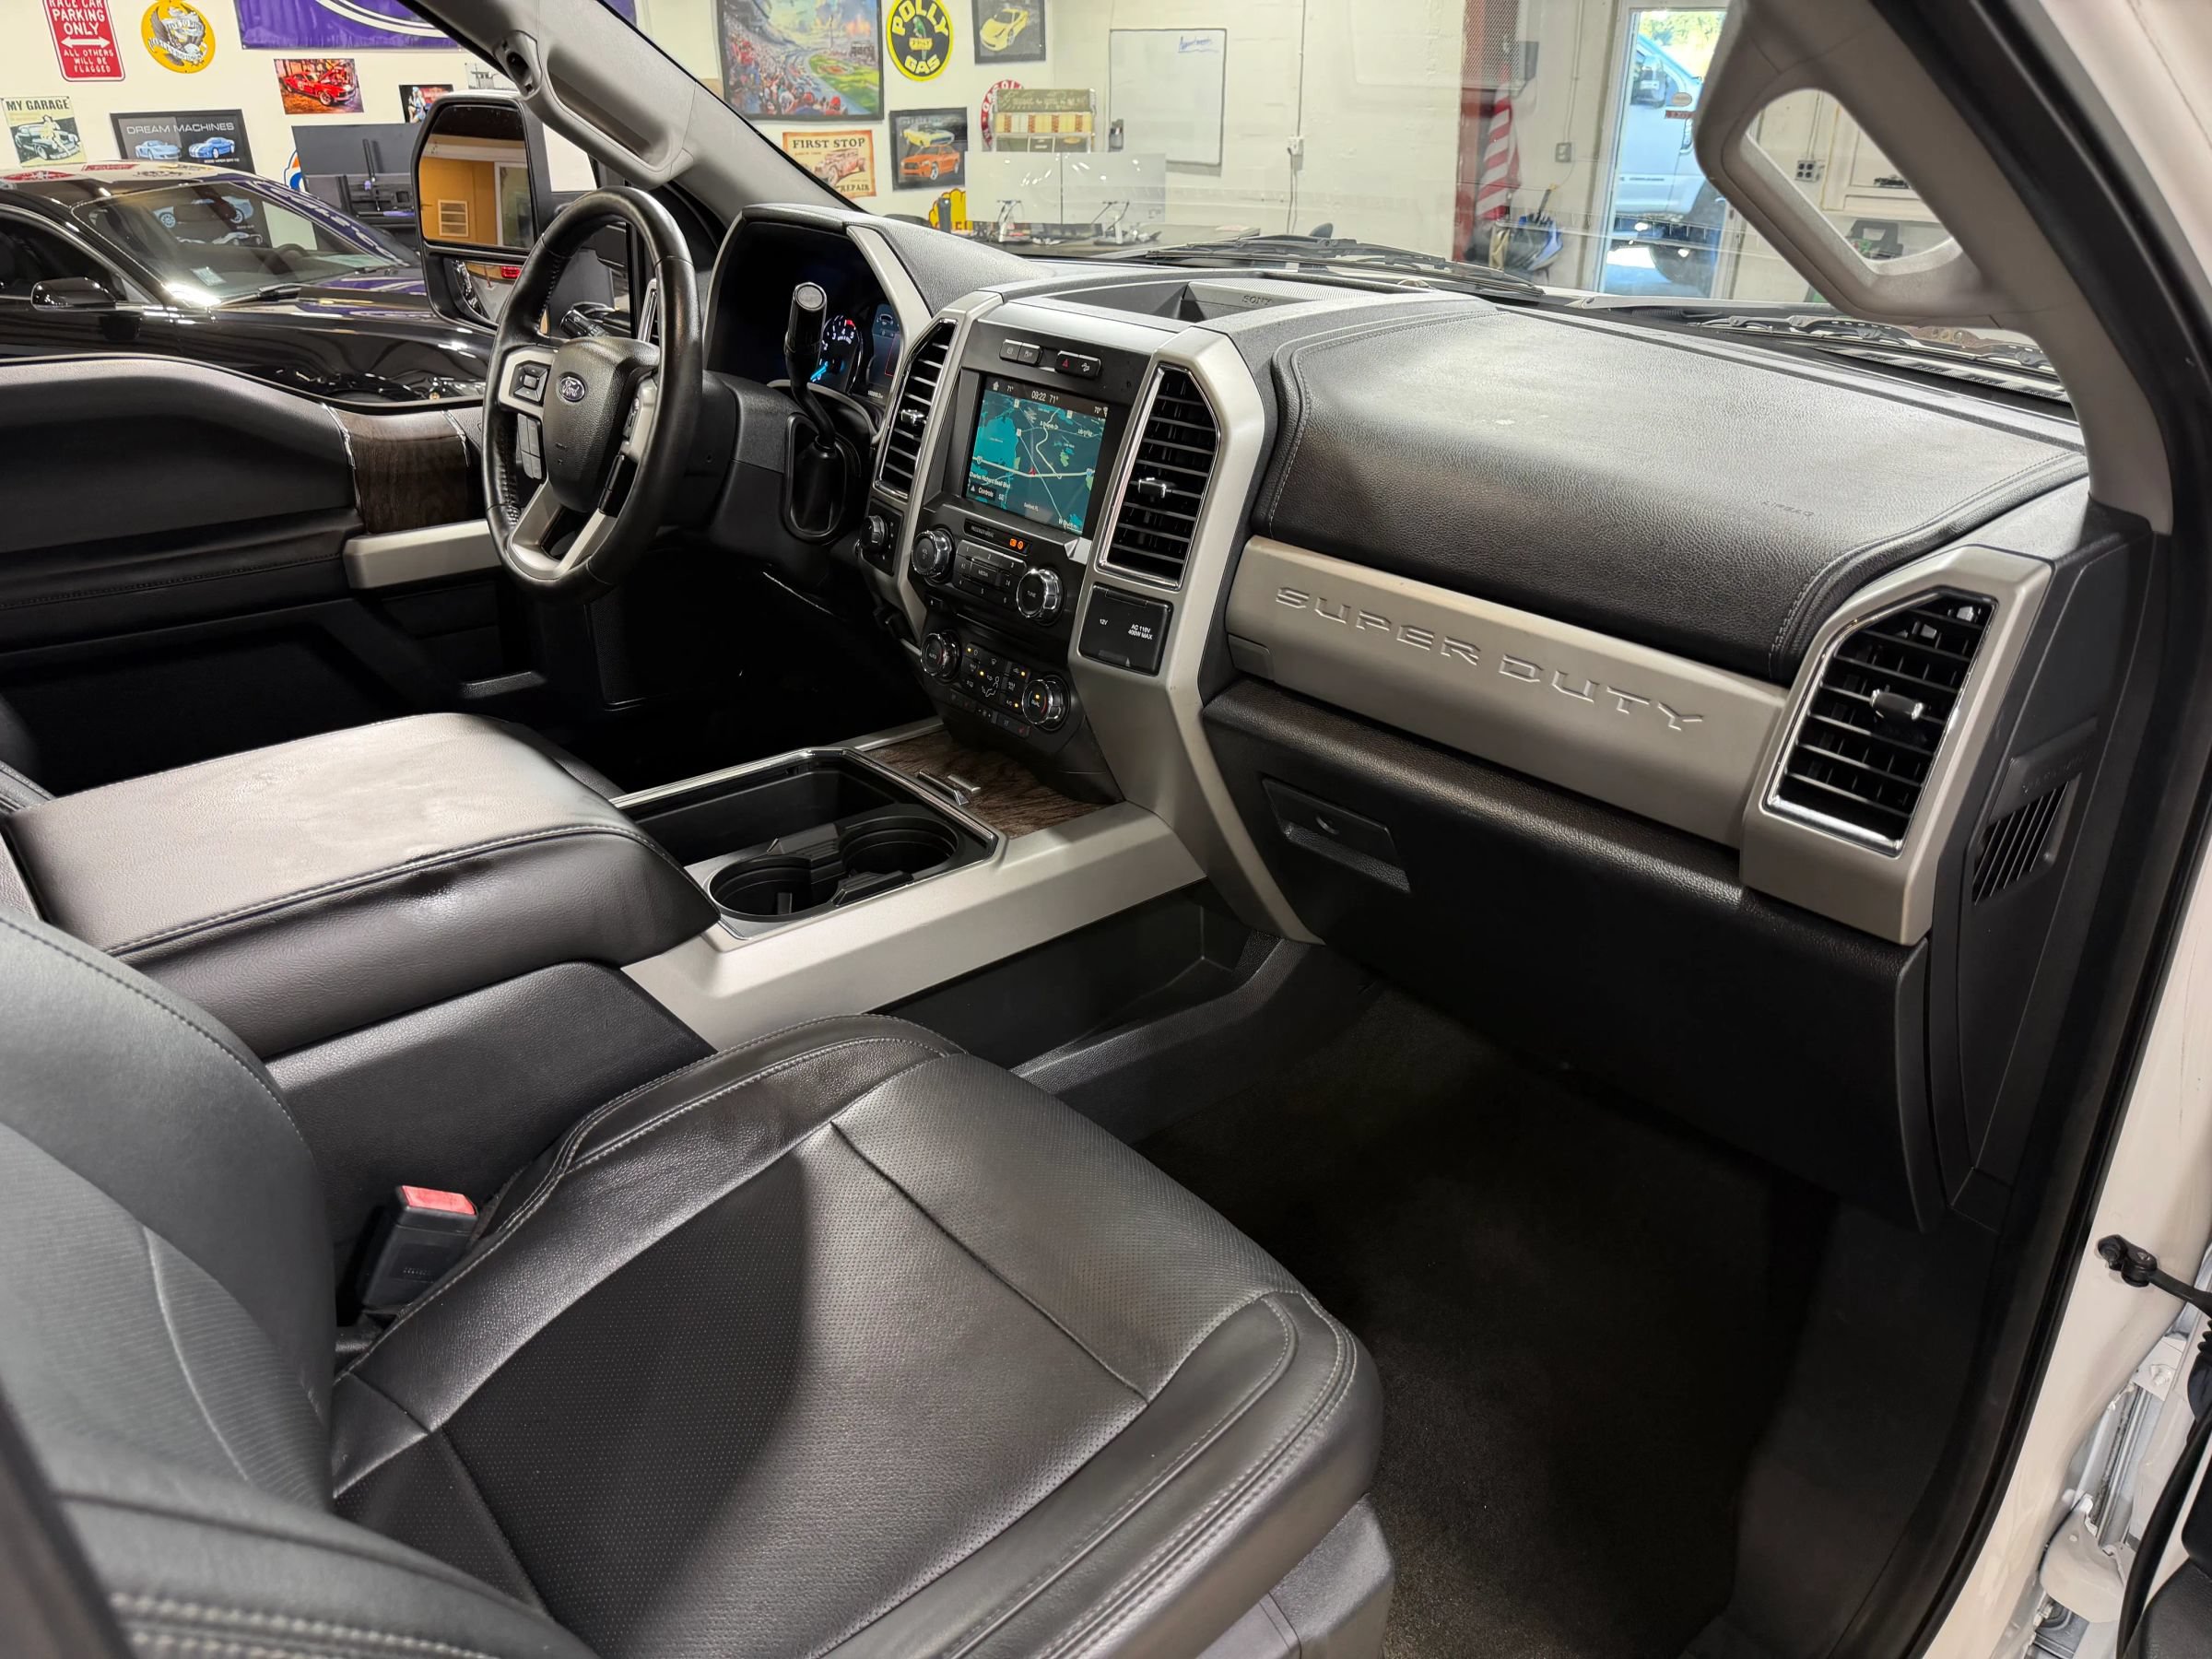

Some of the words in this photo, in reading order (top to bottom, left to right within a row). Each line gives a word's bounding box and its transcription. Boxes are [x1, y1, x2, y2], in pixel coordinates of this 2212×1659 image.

[49, 0, 78, 8] RACE
[81, 0, 103, 8] CAR
[52, 8, 105, 22] PARKING
[891, 0, 949, 37] POLLY
[63, 21, 99, 35] ONLY
[64, 49, 80, 57] ALL
[82, 48, 113, 57] OTHERS
[74, 56, 93, 65] WILL
[96, 56, 108, 65] BE
[904, 53, 941, 74] GAS
[74, 65, 112, 73] FLAGGED
[6, 100, 22, 112] MY
[25, 99, 70, 111] GARAGE
[126, 125, 171, 135] DREAM
[173, 122, 235, 134] MACHINES
[793, 139, 830, 148] FIRST
[833, 137, 865, 148] STOP
[1241, 295, 1273, 306] SONY
[1275, 586, 1480, 666] SUPER
[1498, 653, 1703, 731] DUTY
